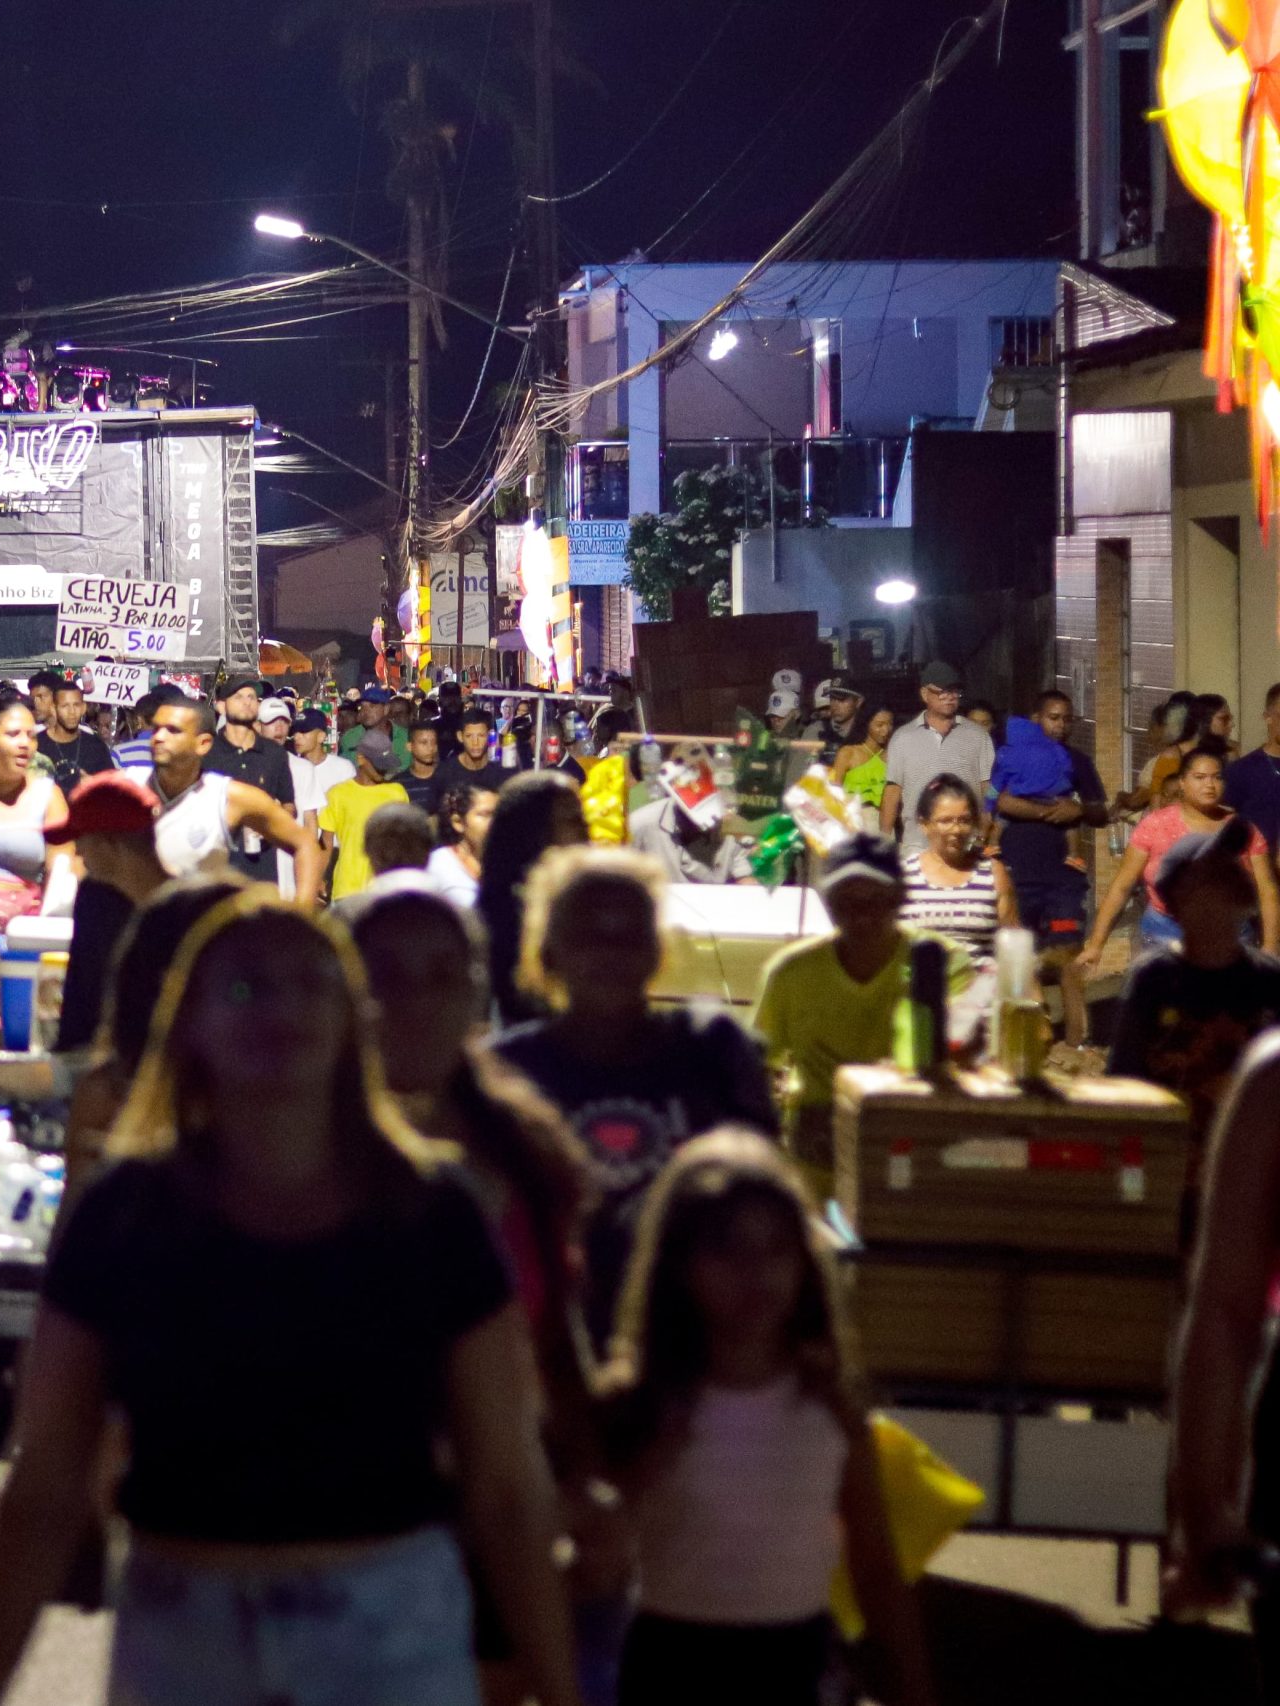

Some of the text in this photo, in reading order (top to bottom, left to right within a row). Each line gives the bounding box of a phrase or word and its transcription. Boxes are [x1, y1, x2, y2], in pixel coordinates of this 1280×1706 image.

[567, 523, 626, 538] ADEIREIRA
[568, 540, 577, 554] SA
[591, 540, 625, 554] APARECIDA
[31, 586, 55, 599] Biz
[67, 579, 177, 609] CERVEJA
[188, 578, 203, 636] BIZ
[109, 606, 120, 623] 3
[124, 609, 148, 626] POR
[499, 619, 520, 627] SELA
[128, 631, 166, 651] 5.00
[94, 665, 141, 680] ACEITO
[105, 682, 135, 701] PIX
